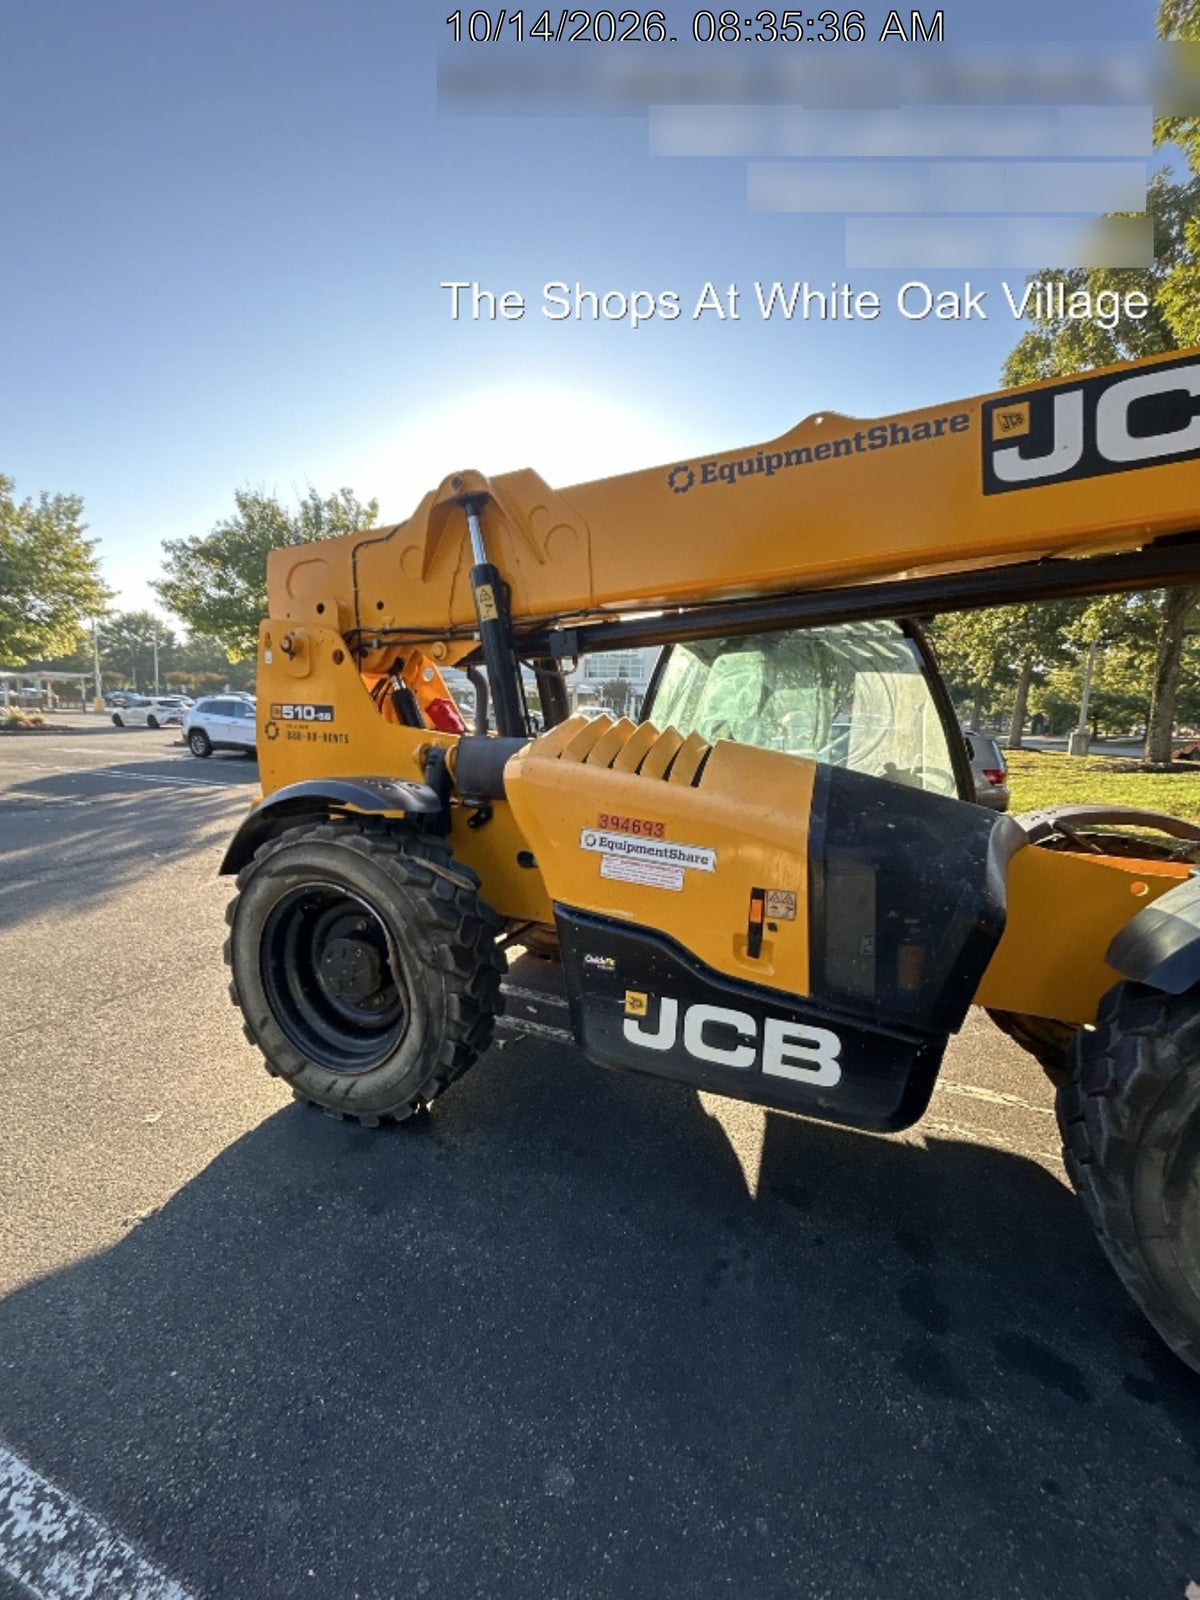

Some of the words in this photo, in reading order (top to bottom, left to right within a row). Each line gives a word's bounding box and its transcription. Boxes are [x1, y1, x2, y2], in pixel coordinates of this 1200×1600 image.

[700, 411, 970, 484] EquipmentShare
[599, 813, 665, 837] 394693
[598, 836, 709, 866] EquipmentShare
[623, 996, 842, 1087] JCB
